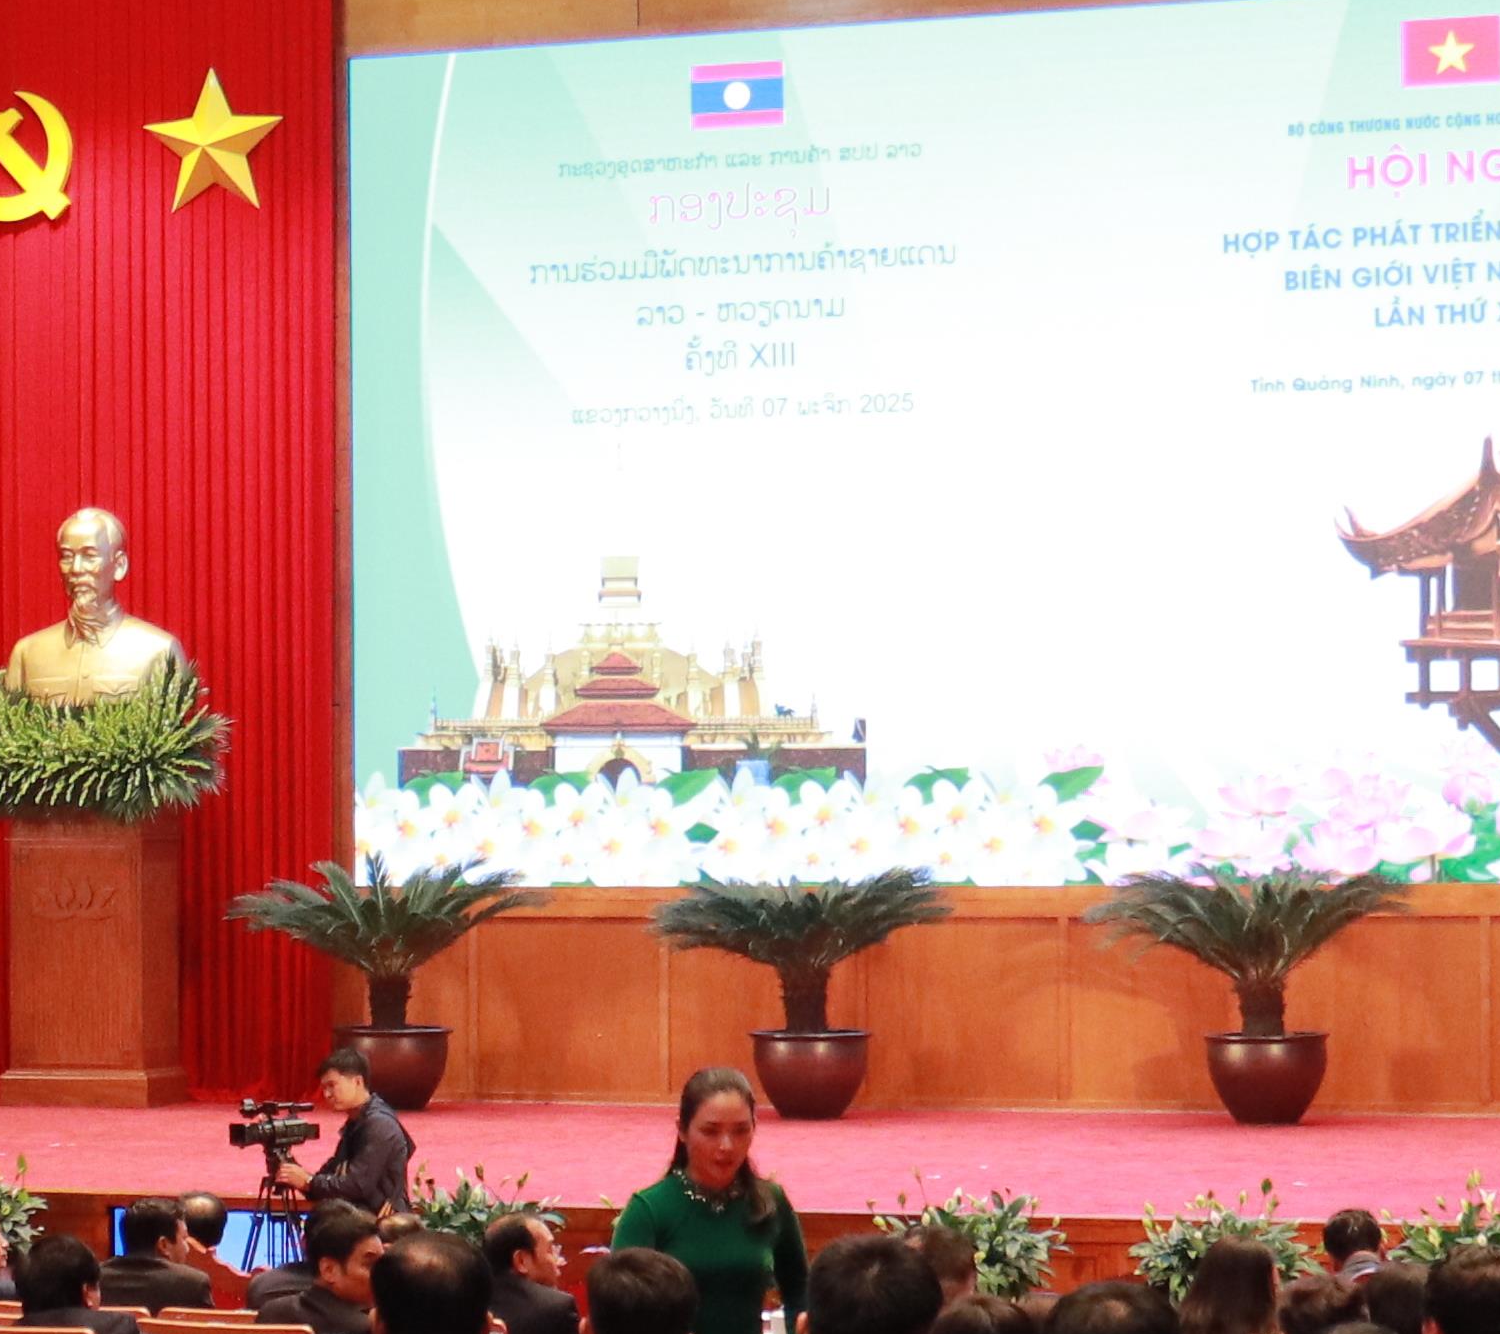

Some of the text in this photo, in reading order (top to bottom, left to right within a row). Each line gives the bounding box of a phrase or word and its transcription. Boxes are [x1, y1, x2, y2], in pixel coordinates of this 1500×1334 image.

[1347, 144, 1427, 198] HỘI
[649, 183, 831, 237] ກອງປະຊຸມ
[1223, 229, 1279, 258] HỢP
[1288, 223, 1342, 250] TÁC
[1352, 217, 1421, 248] PHÁT
[1284, 264, 1341, 291] BIÊN
[1352, 257, 1412, 287] GIỚI
[1423, 257, 1476, 289] VIỆT
[636, 305, 685, 326] ລາວ
[1435, 295, 1490, 324] THỨ
[750, 342, 795, 367] XIII
[1412, 369, 1457, 389] ngày
[1464, 369, 1484, 386] 07
[762, 398, 788, 417] 07
[860, 393, 914, 414] 2025
